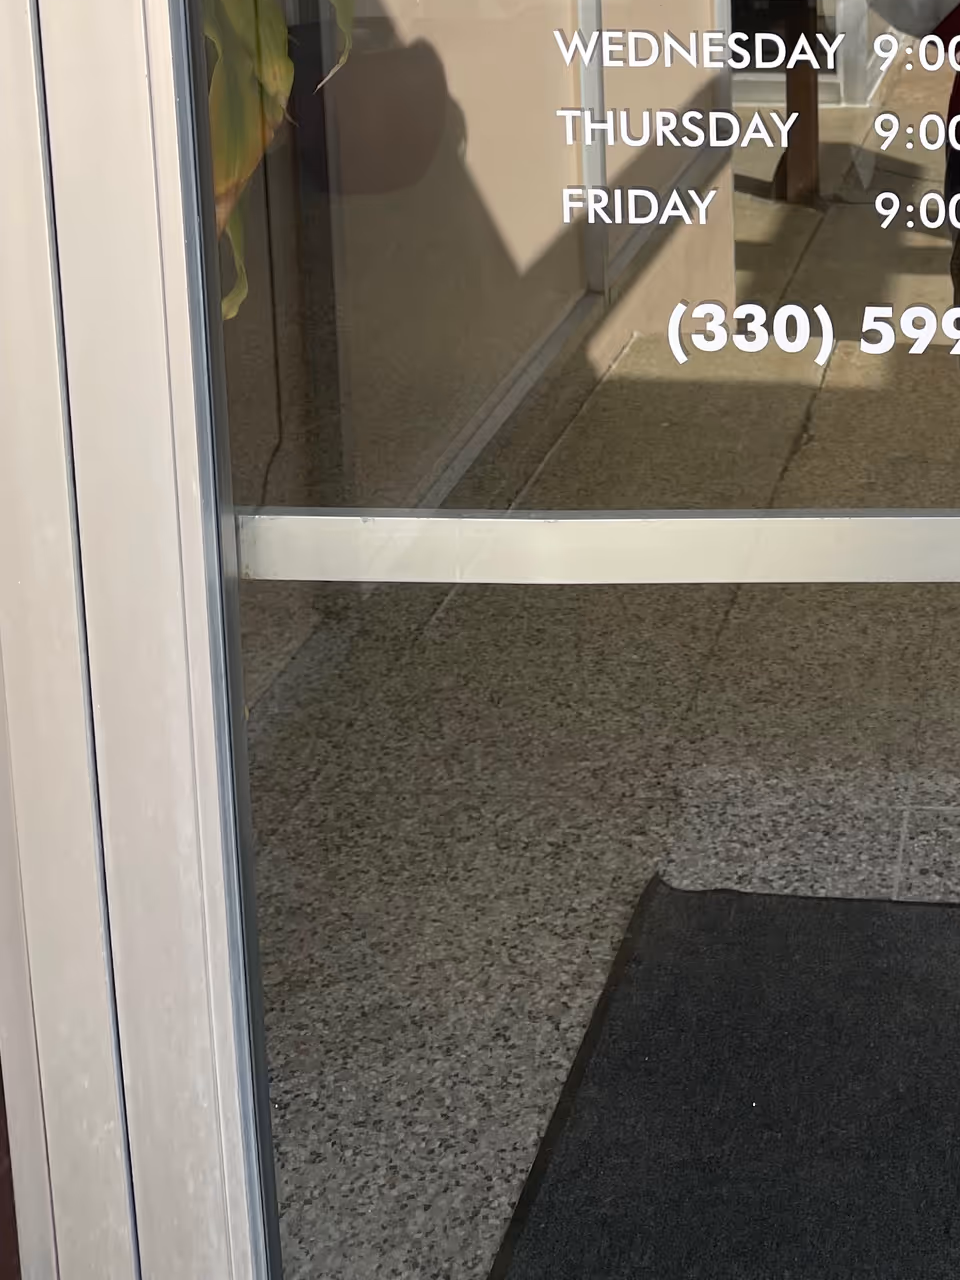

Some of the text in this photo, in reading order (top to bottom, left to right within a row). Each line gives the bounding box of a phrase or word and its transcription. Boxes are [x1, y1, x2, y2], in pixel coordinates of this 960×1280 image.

[553, 30, 845, 69] WEDNESDAY
[556, 110, 799, 148] THURSDAY
[562, 188, 717, 225] FRIDAY
[668, 302, 834, 367] (330)
